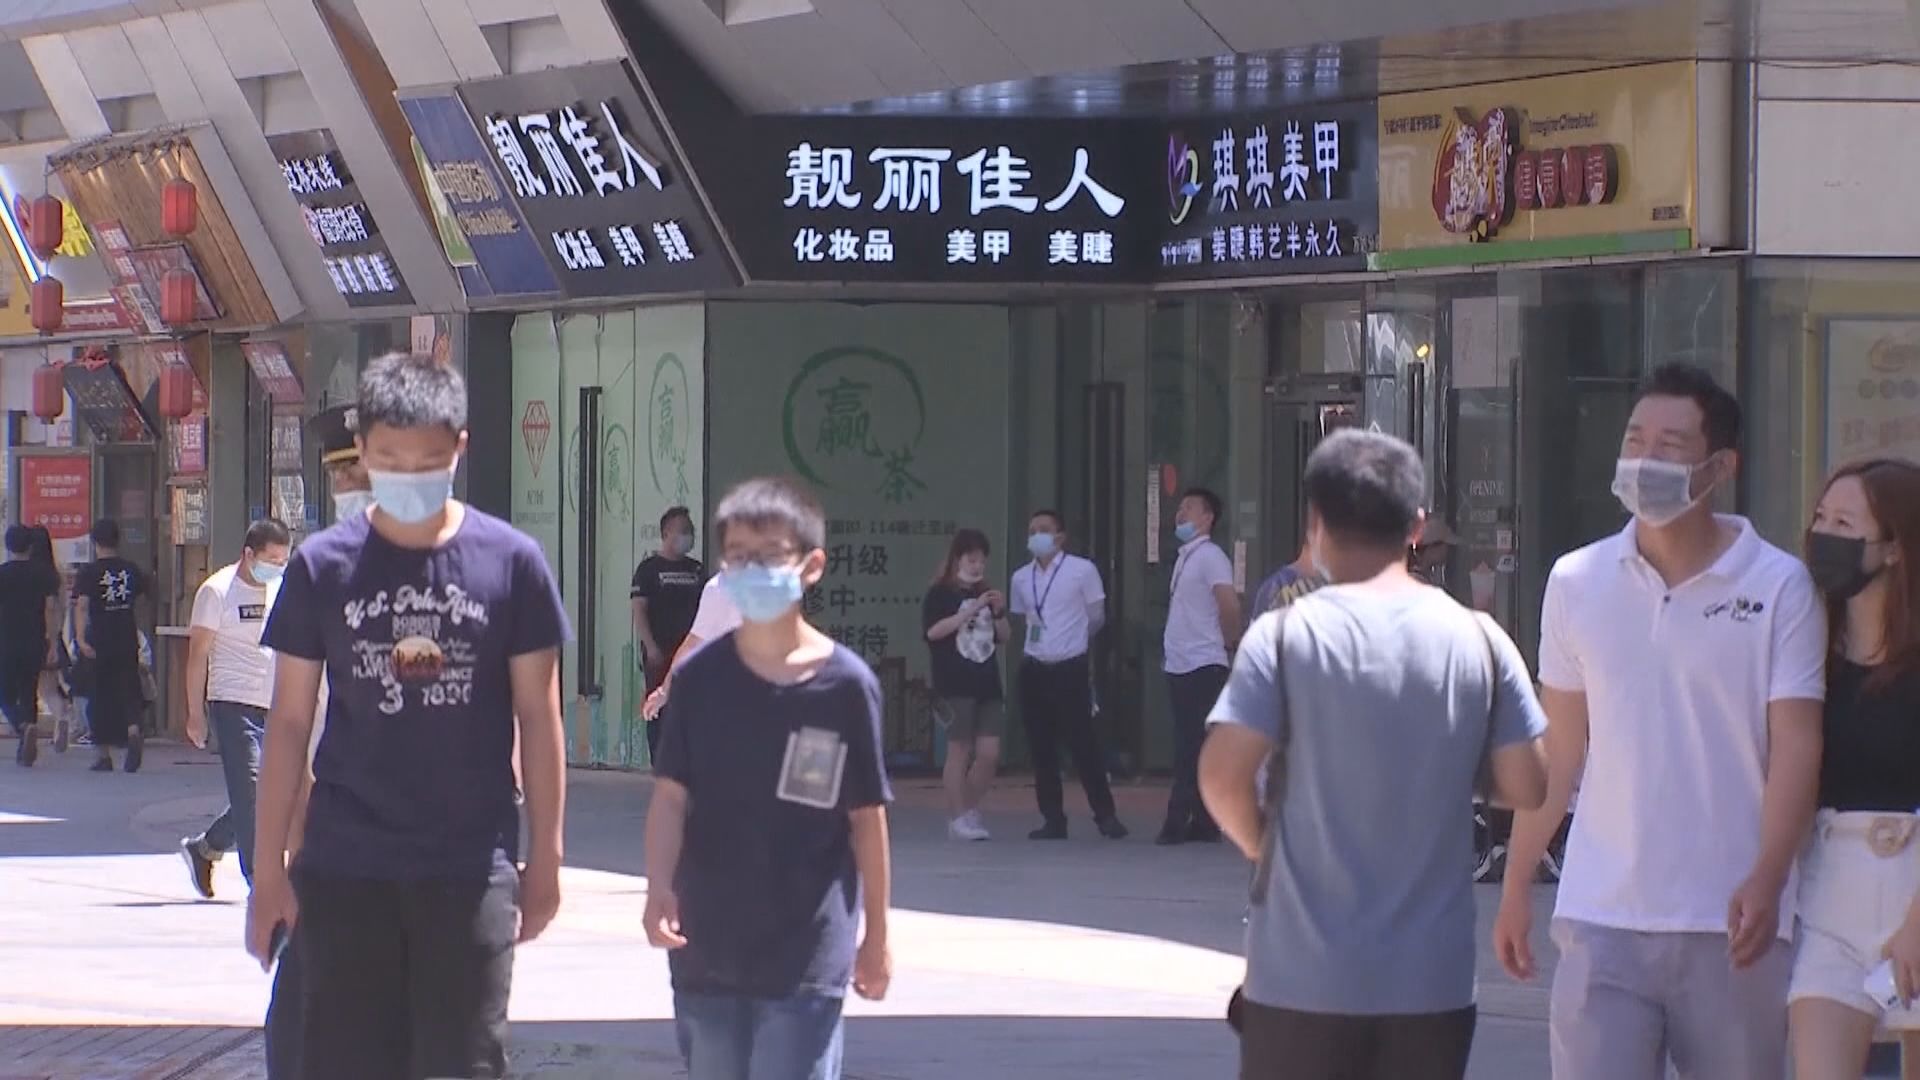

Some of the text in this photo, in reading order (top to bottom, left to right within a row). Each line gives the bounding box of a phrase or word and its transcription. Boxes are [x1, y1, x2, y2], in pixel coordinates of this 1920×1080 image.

[485, 101, 663, 198] 靓丽佳人
[1212, 119, 1339, 212] 琪琪美甲
[784, 142, 1125, 217] 靓丽佳人
[552, 219, 695, 270] 化妆品 美甲 美睫
[794, 228, 1113, 264] 化妆品 美甲 美睫
[1212, 218, 1342, 263] 美睫韩艺半永久
[367, 590, 389, 618] S.
